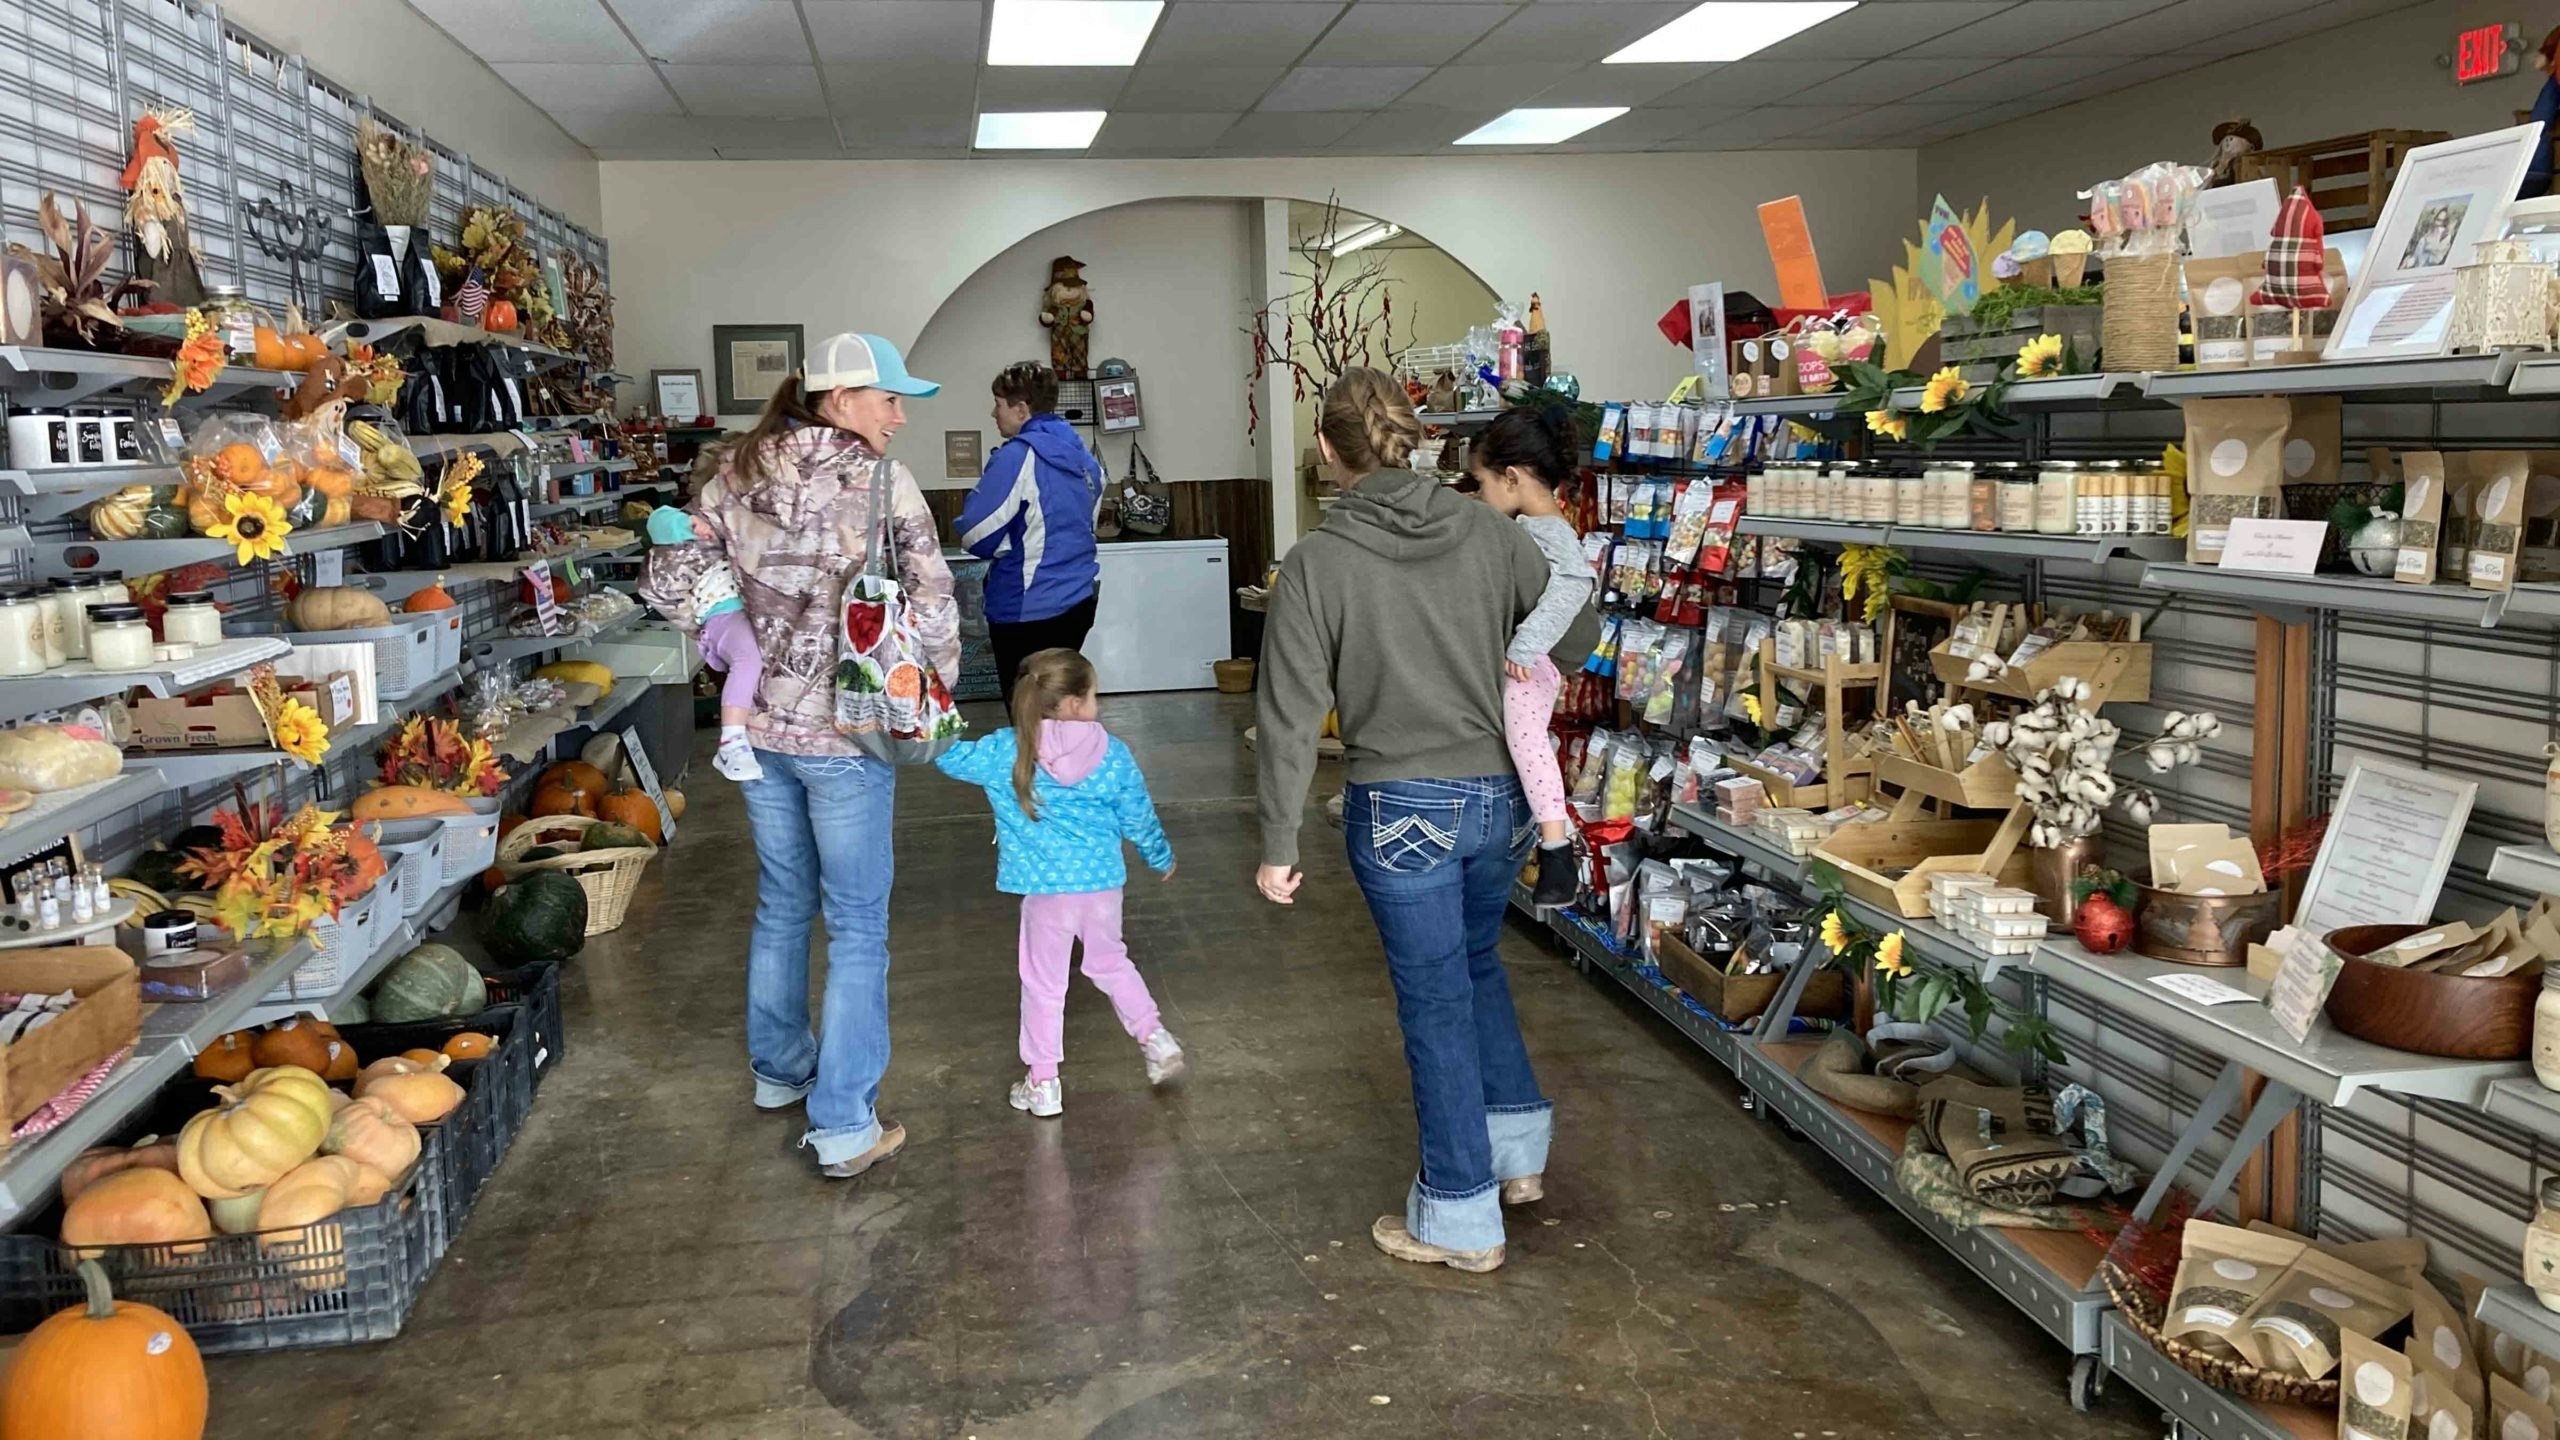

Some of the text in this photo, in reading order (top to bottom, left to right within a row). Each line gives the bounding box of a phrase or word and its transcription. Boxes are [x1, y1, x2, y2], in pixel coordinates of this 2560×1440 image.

[2458, 23, 2503, 80] EXIT
[139, 731, 216, 744] Grown Fresh
